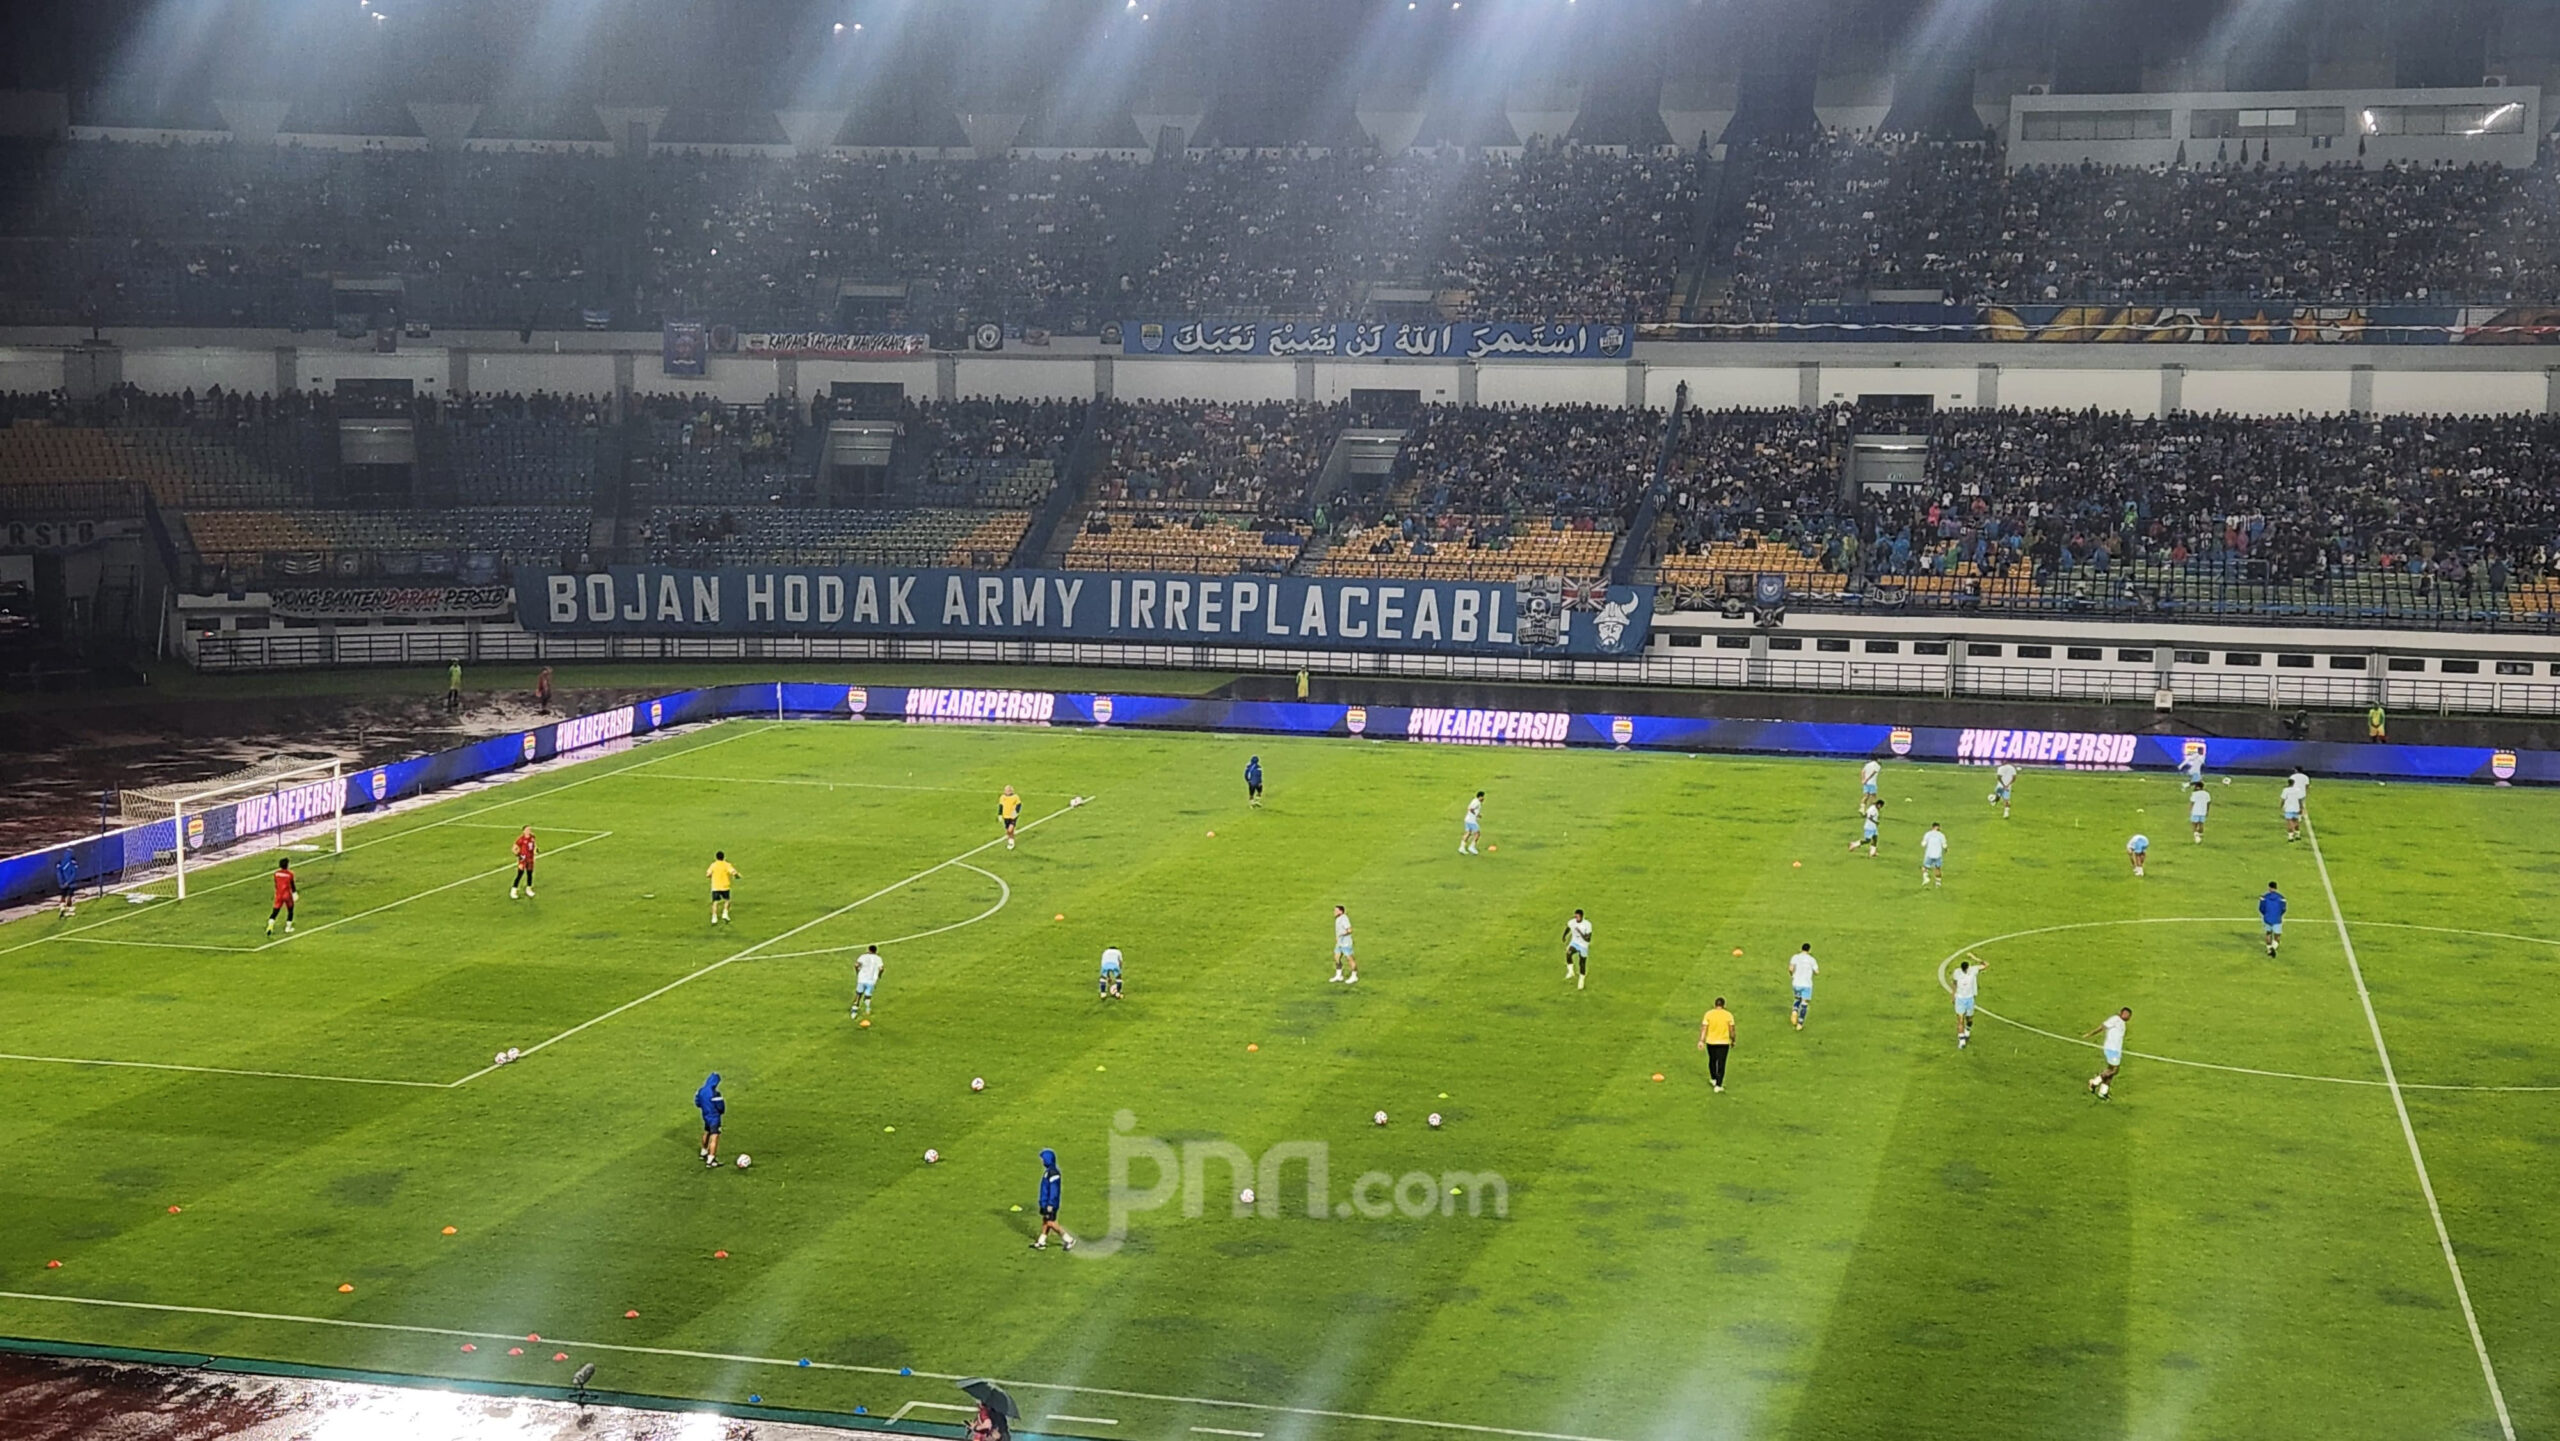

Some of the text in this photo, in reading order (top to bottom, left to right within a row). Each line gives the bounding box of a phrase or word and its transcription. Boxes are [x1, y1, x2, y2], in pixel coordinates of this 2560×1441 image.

[547, 574, 1571, 646] BOJAN HODAK ARMY IRREPLACEABL!
[904, 688, 1056, 720] #WEAREPERSIB
[555, 705, 635, 752] #WEAREPERSIB
[1407, 707, 1570, 741] #WEAREPERSIB
[1957, 728, 2138, 764] #WEAREPERSIB
